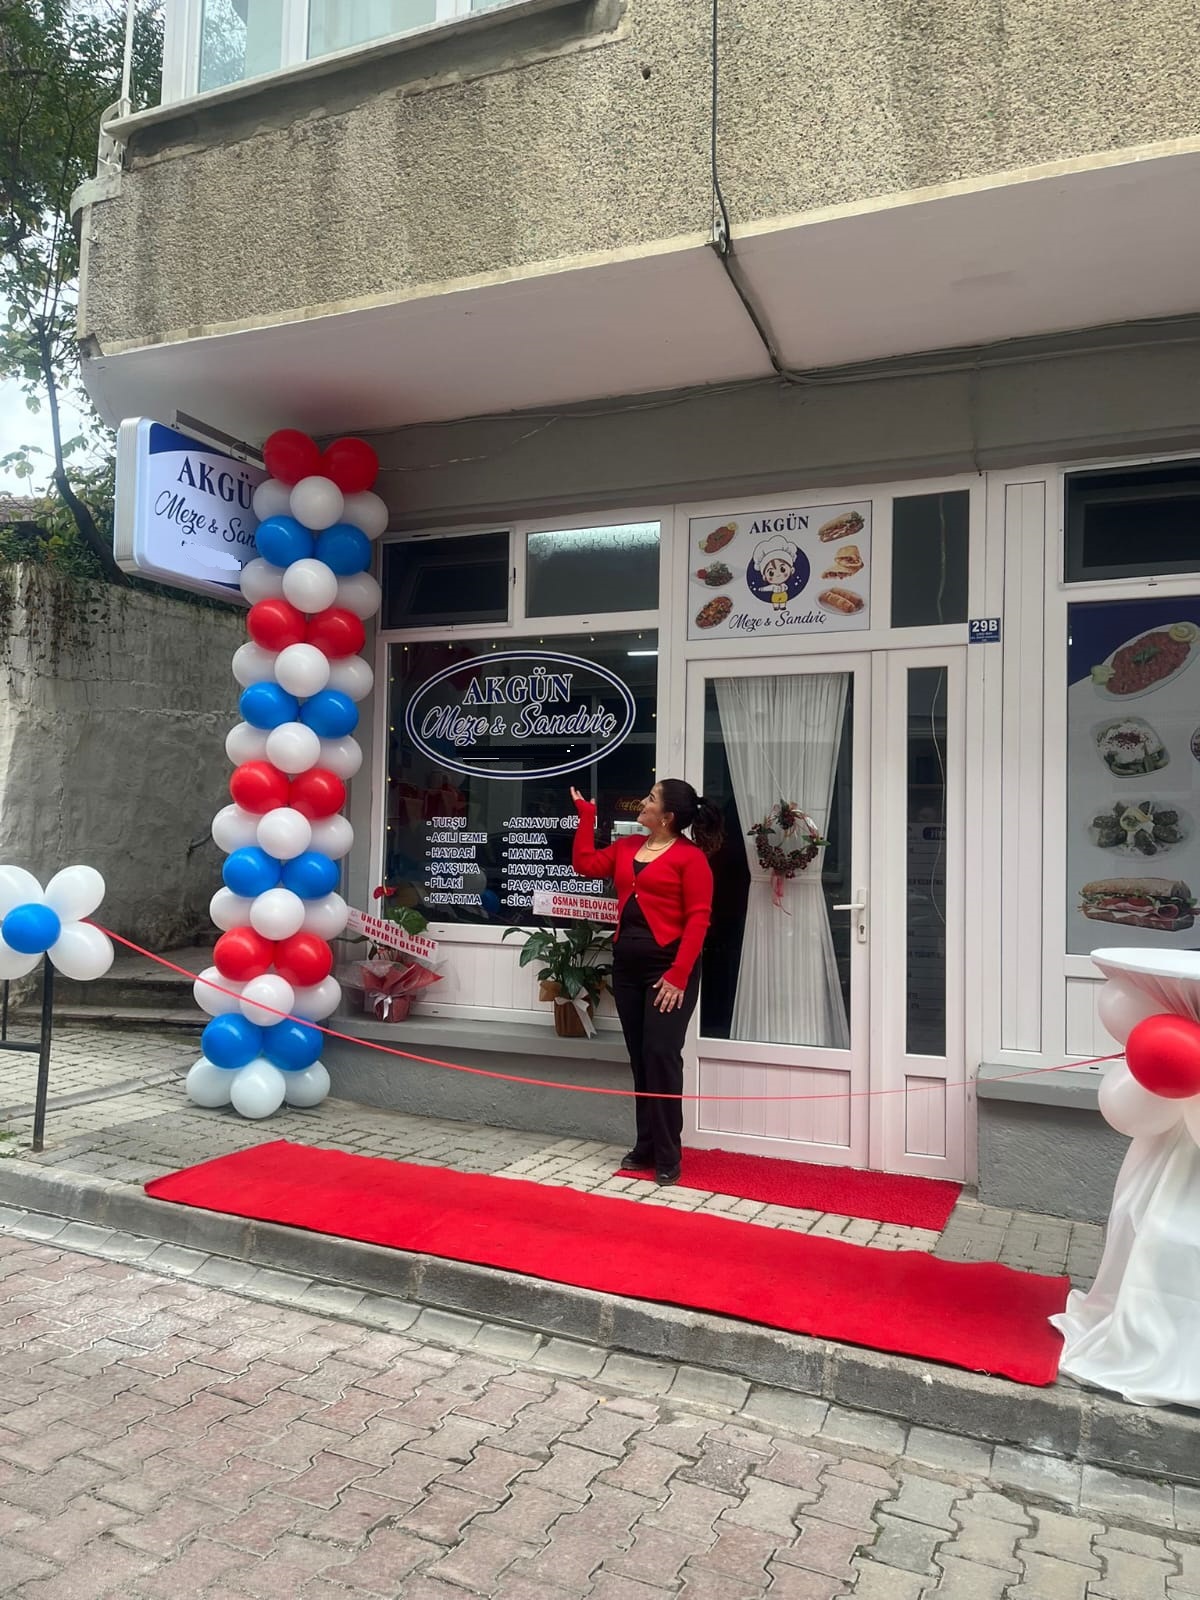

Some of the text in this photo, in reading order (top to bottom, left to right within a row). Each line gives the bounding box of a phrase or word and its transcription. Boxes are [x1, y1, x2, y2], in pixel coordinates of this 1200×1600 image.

[176, 456, 256, 509] AKGÜ
[154, 490, 206, 535] Meze
[208, 518, 218, 533] &
[749, 513, 809, 535] AKGÜN
[728, 610, 827, 632] Meze & Sandviç
[972, 620, 998, 633] 29B
[462, 667, 573, 706] AKGÜN
[421, 703, 617, 746] Meze & Sandviç
[459, 832, 488, 844] EZME
[560, 879, 603, 893] BÖREĞİ
[507, 893, 534, 907] SİGA
[551, 906, 571, 916] GERZE
[552, 896, 619, 912] OSMAN BELOVACIK
[364, 925, 429, 957] HAYIRLI OLSUN
[384, 922, 404, 938] OTEL
[408, 933, 437, 950] GERZE
